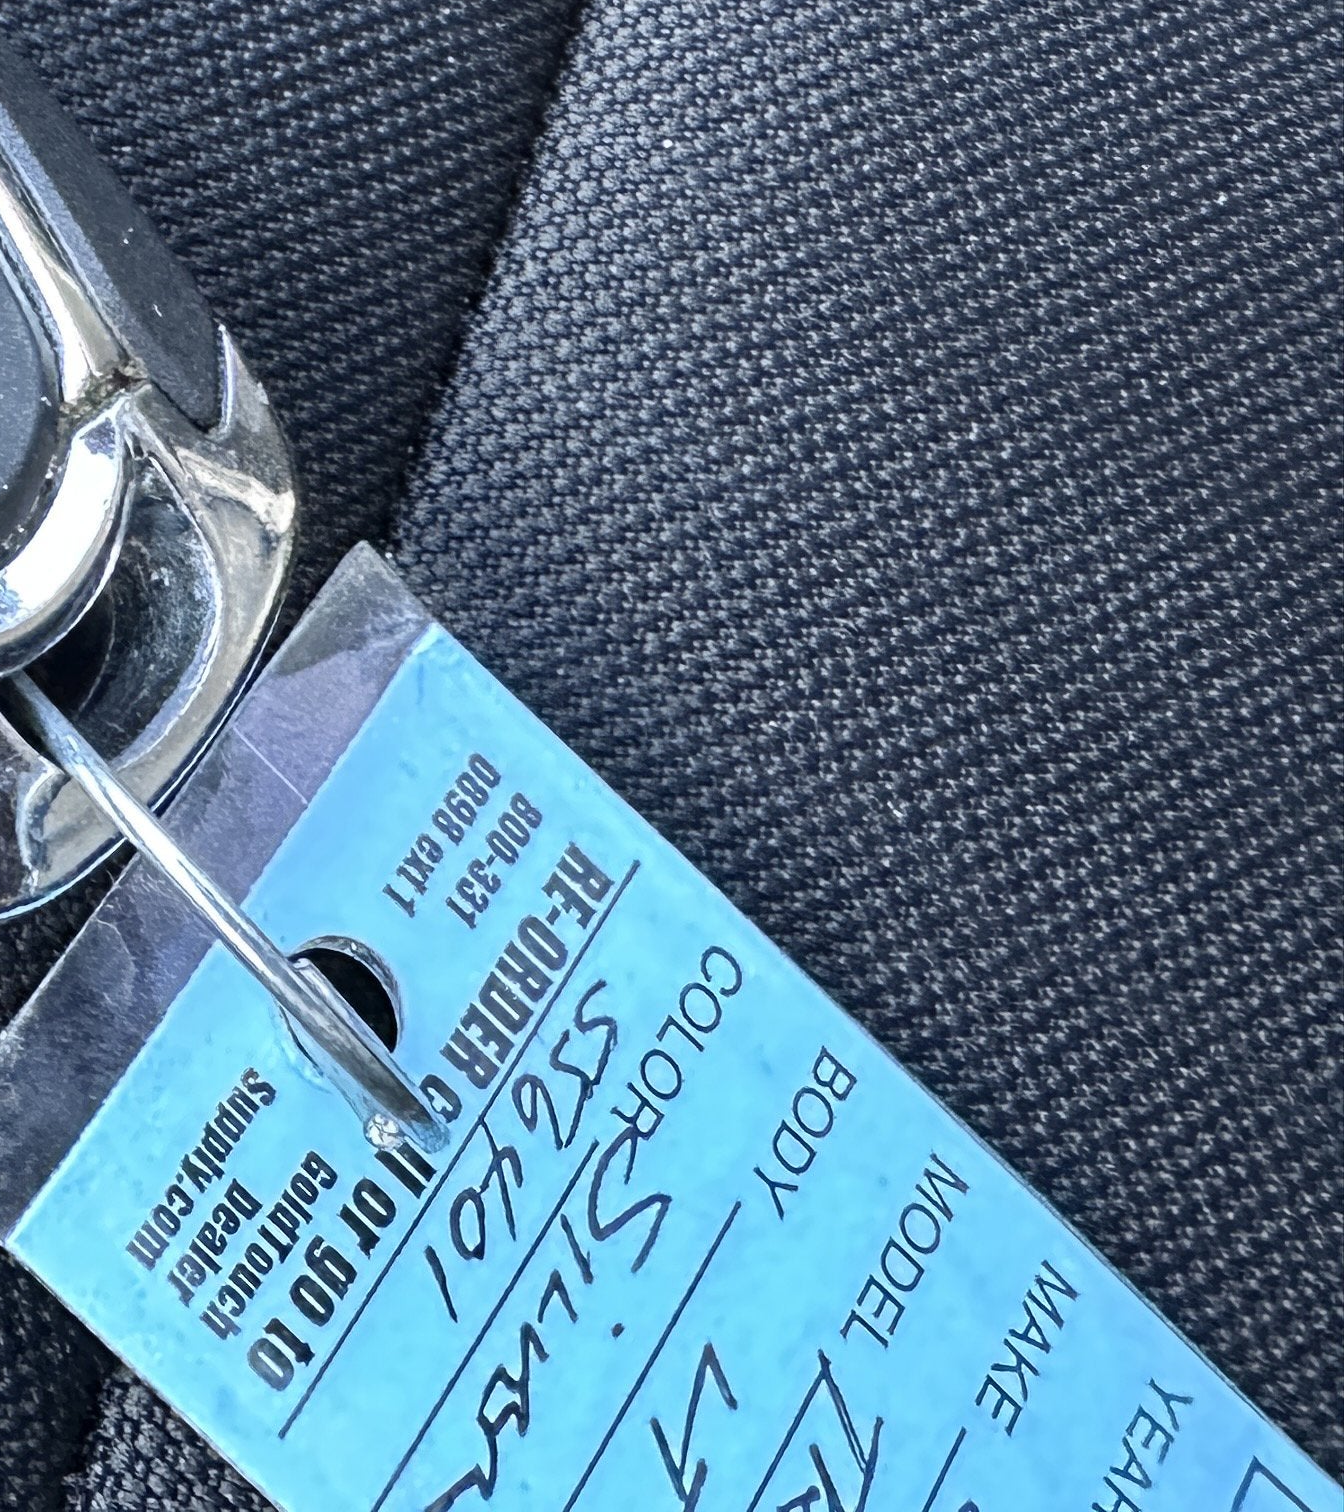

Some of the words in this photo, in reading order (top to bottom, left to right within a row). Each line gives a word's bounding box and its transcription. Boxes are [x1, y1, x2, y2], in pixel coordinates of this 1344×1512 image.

[396, 833, 444, 895] ext
[431, 752, 502, 846] 0898
[445, 792, 543, 929] 800-331
[381, 883, 416, 918] 1
[440, 840, 615, 1090] RE-ORDER
[610, 945, 743, 1184] COLOR
[753, 1045, 857, 1220] BODY
[125, 1066, 277, 1271] Supply.com
[374, 1074, 462, 1199] cll
[424, 978, 619, 1324] 556401
[166, 1178, 263, 1308] Dealer
[199, 1150, 338, 1341] GoldTouch
[289, 1235, 358, 1327] go
[336, 1176, 396, 1259] or
[840, 1150, 970, 1348] MODEL
[247, 1317, 316, 1391] to
[973, 1259, 1081, 1438] MAKE
